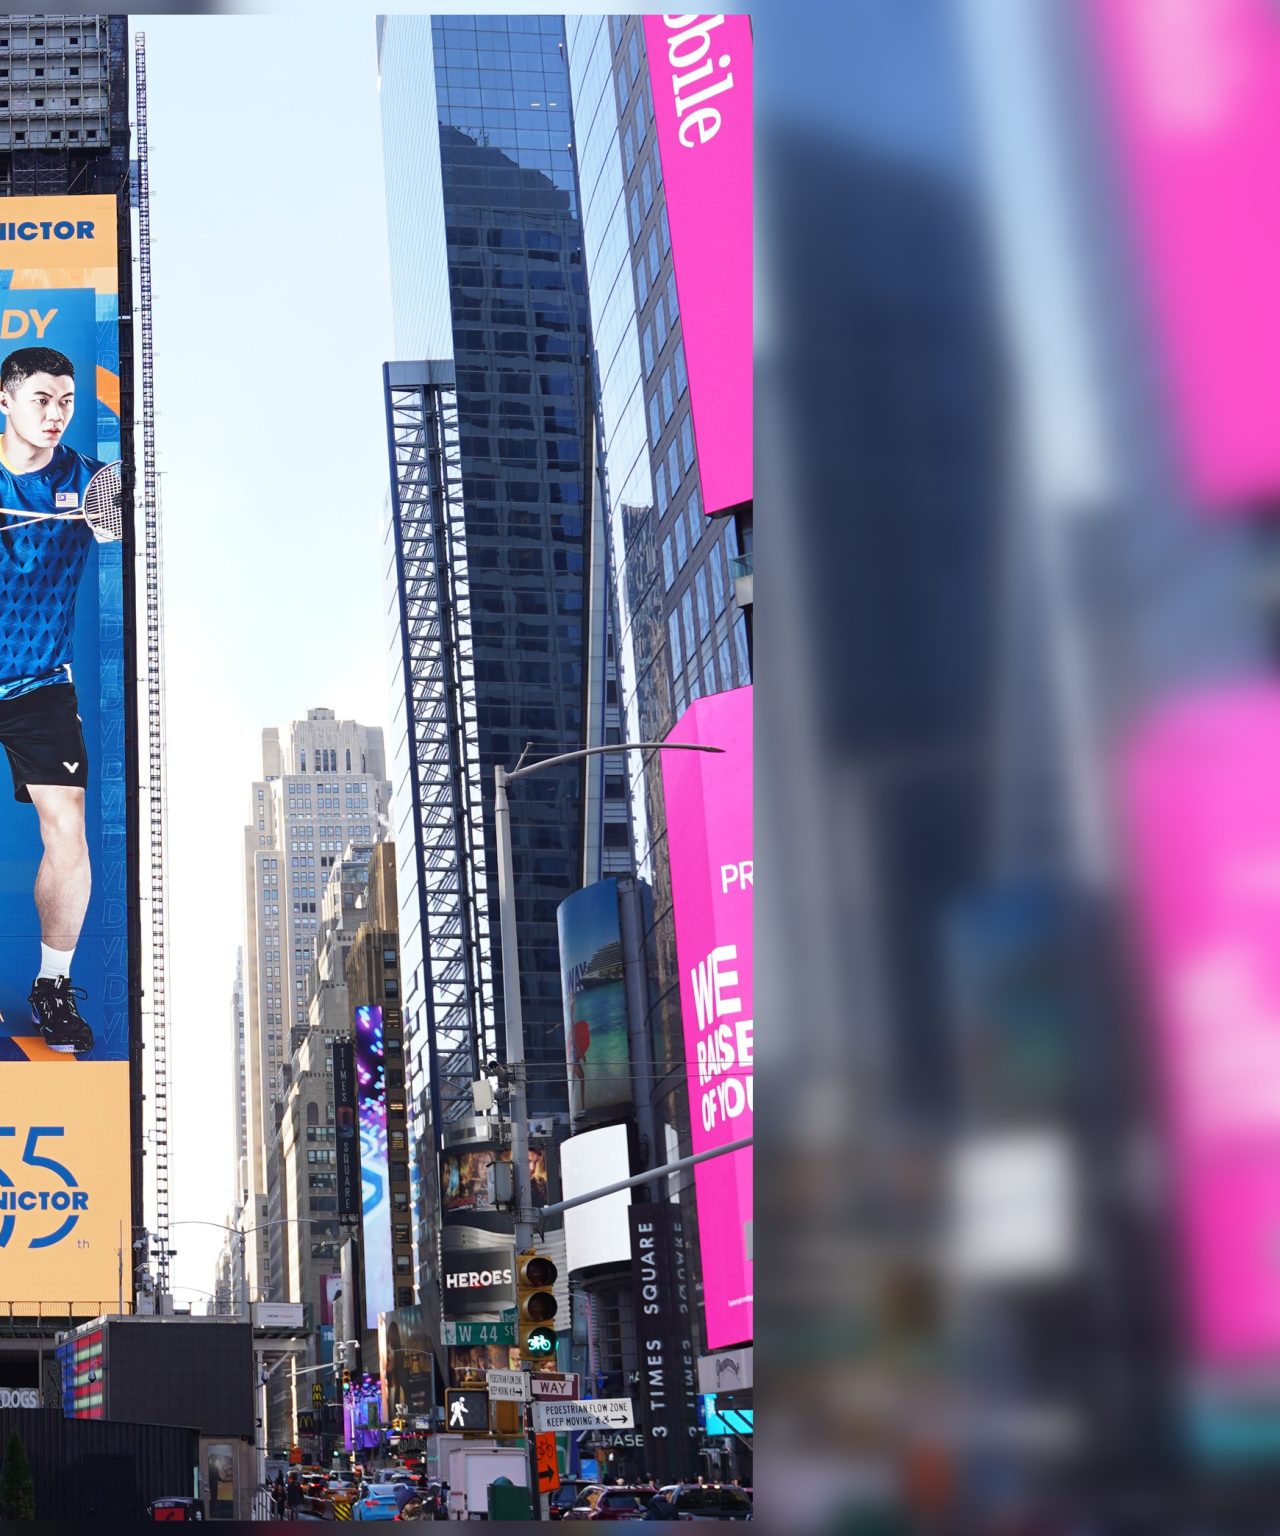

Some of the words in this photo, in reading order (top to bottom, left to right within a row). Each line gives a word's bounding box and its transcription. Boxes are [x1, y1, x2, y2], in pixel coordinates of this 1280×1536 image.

[721, 861, 753, 894] PR
[691, 944, 742, 1031] WE
[697, 1019, 753, 1087] RAISE
[702, 1088, 718, 1132] OF
[77, 1239, 90, 1248] th
[638, 1223, 658, 1314] SQUARE
[446, 1269, 512, 1289] HEROES
[459, 1325, 472, 1342] W
[480, 1325, 498, 1342] 44
[504, 1325, 514, 1336] St
[647, 1340, 666, 1410] TIMES
[540, 1382, 566, 1394] WAY
[545, 1405, 588, 1415] PEDESTRIAN
[590, 1404, 608, 1413] FLOW
[610, 1402, 628, 1412] ZONE
[547, 1418, 564, 1427] KEEP
[566, 1417, 592, 1427] MOVING
[652, 1426, 667, 1437] 3
